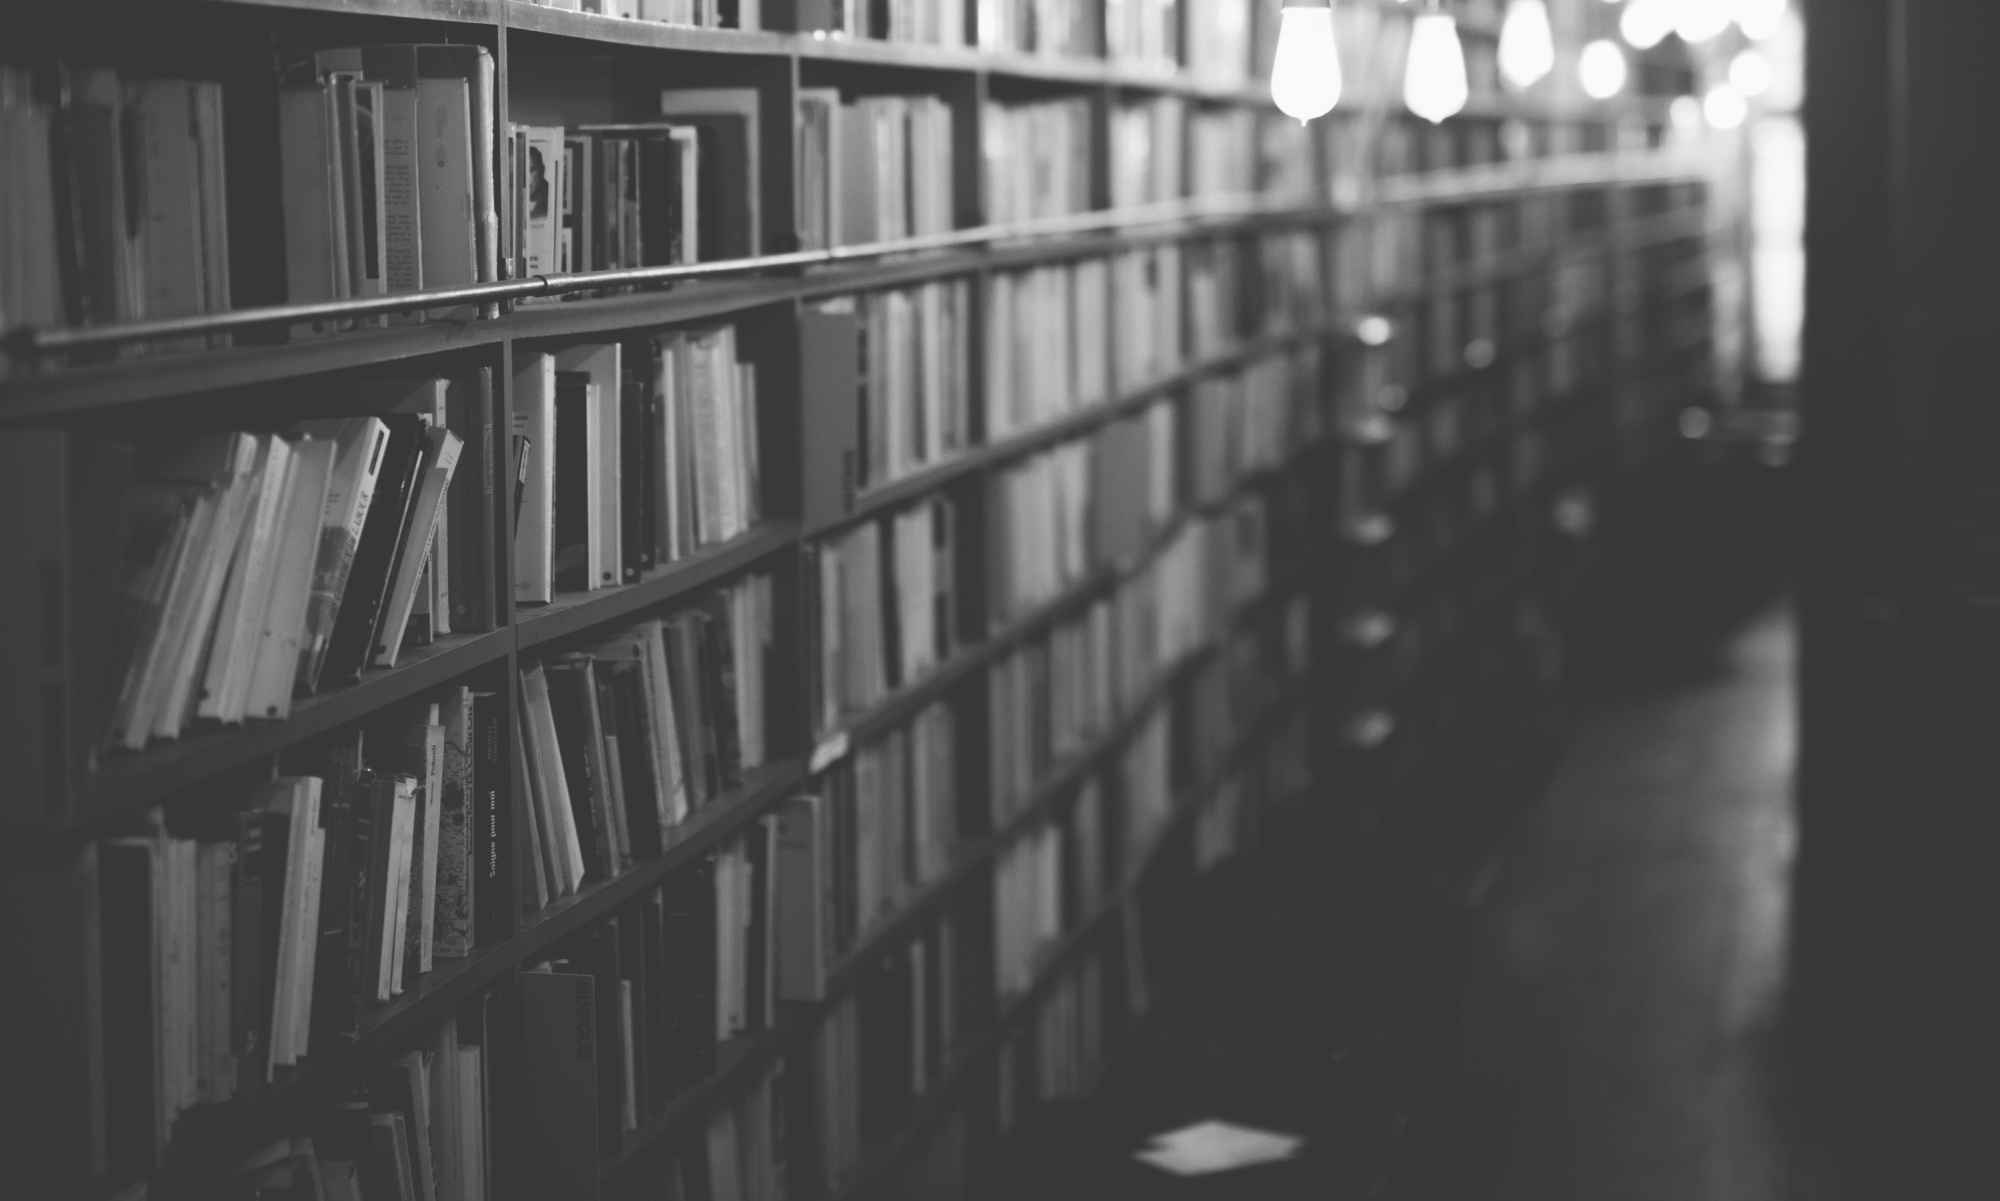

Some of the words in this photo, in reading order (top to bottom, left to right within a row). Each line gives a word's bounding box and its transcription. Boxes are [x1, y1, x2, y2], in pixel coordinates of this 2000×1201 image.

[352, 491, 368, 536] LABOUR
[488, 790, 496, 811] moi
[490, 814, 498, 838] pour
[489, 841, 498, 878] Saigne
[575, 980, 592, 1059] MUSIQUE
